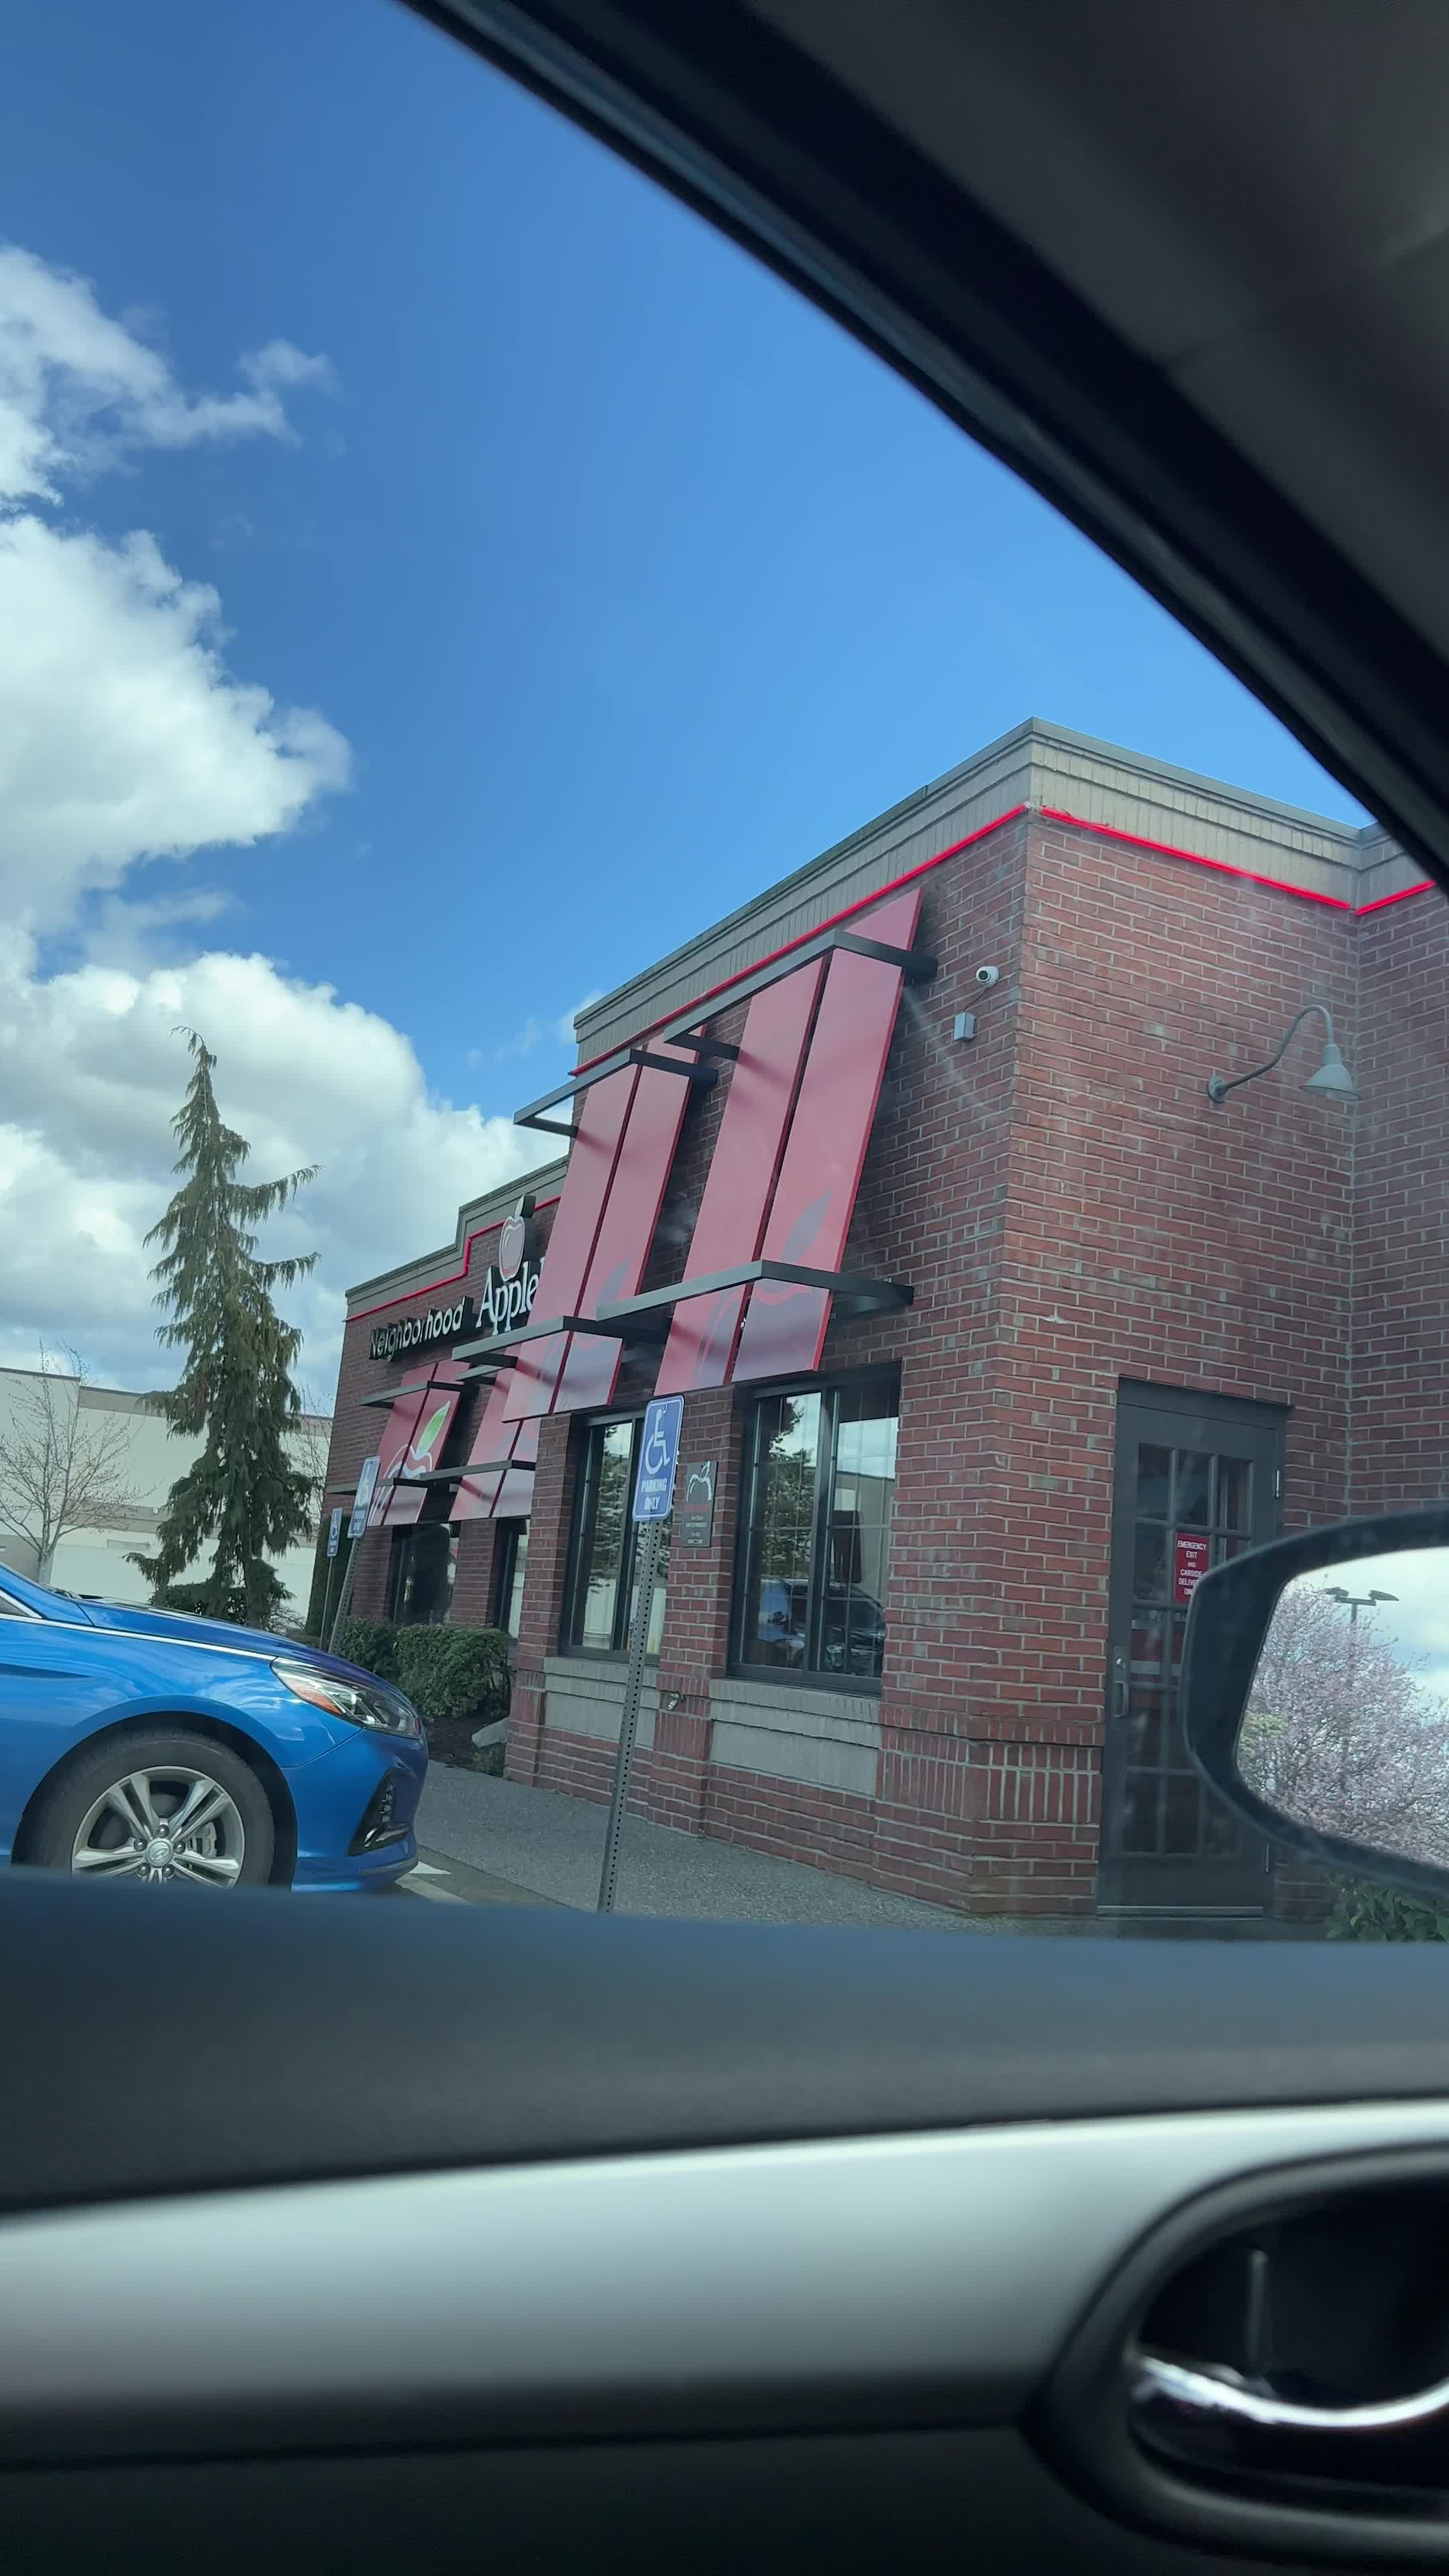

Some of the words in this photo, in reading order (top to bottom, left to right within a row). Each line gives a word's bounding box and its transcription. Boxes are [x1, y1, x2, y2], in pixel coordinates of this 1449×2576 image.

[370, 1297, 466, 1362] Neighborhood
[476, 1258, 543, 1336] Apple
[641, 1478, 667, 1493] PARKING
[644, 1496, 661, 1510] ONLY
[1177, 1540, 1207, 1551] EMERGENCY
[1185, 1550, 1197, 1558] EXIT
